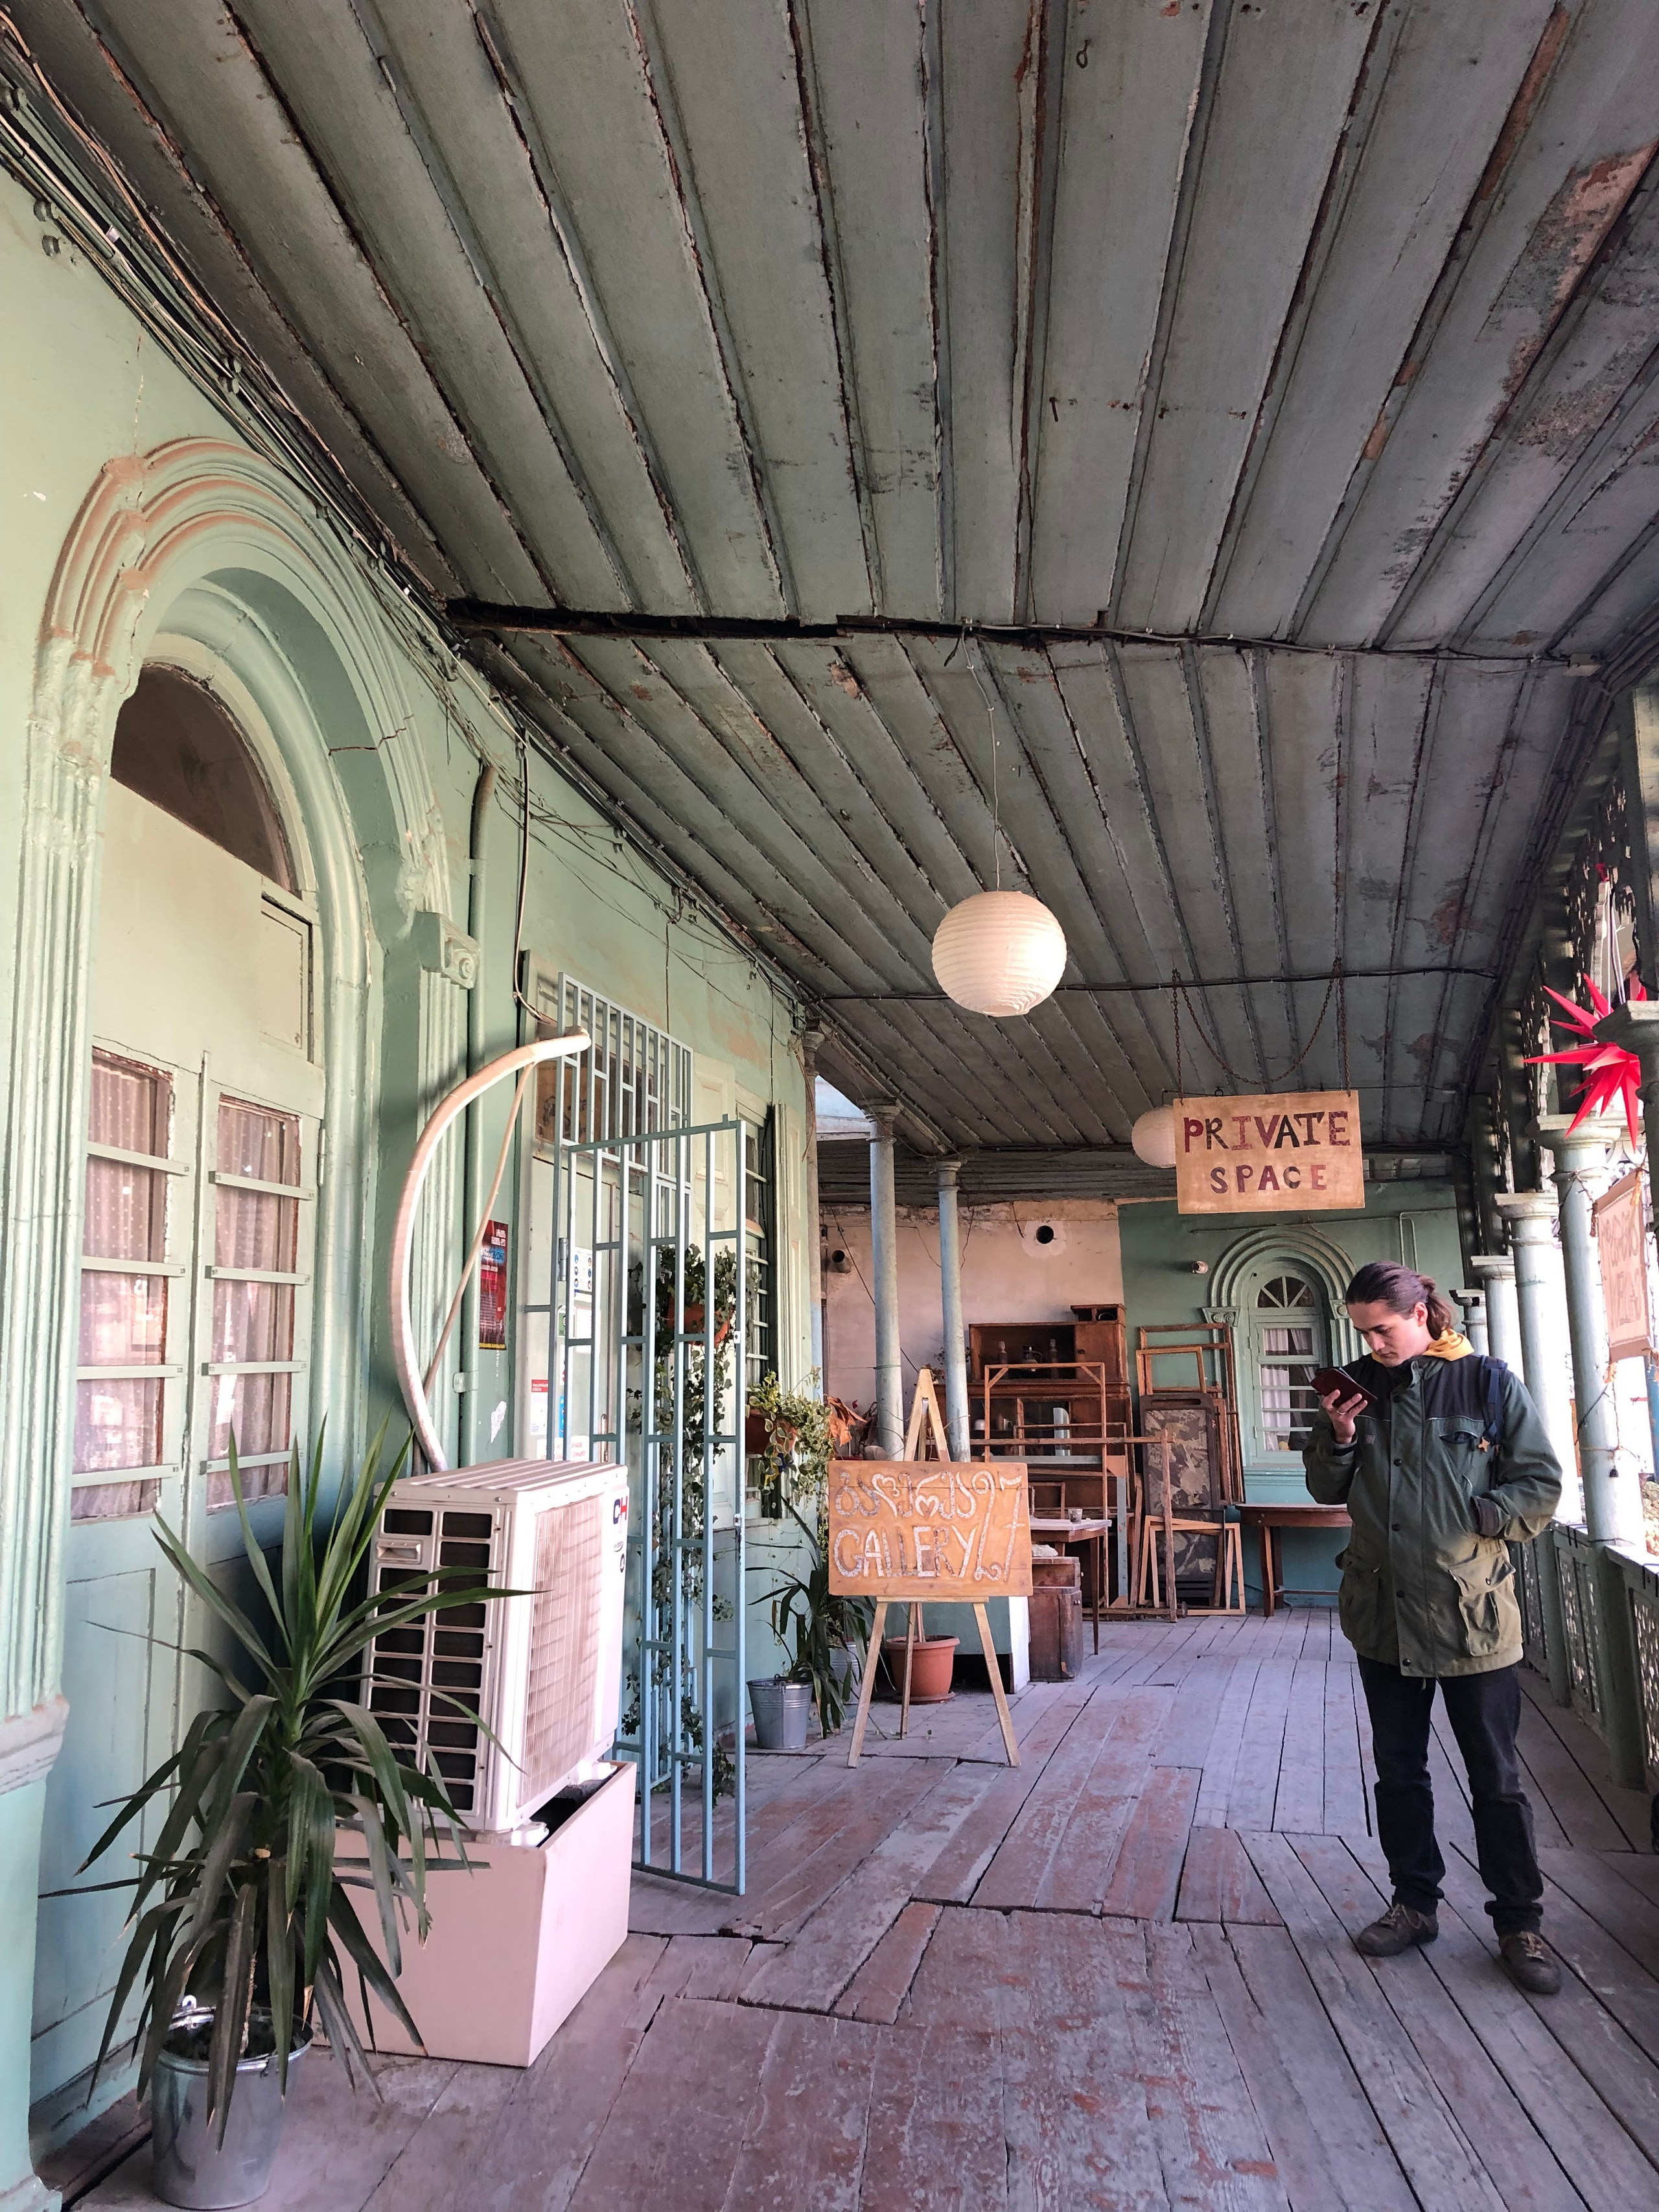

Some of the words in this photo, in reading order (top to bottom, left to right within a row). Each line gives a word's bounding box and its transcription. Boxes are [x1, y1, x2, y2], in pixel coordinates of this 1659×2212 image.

[1183, 1111, 1350, 1152] PRIVATE
[1210, 1164, 1327, 1194] SPACE
[833, 1525, 977, 1578] GALLERY
